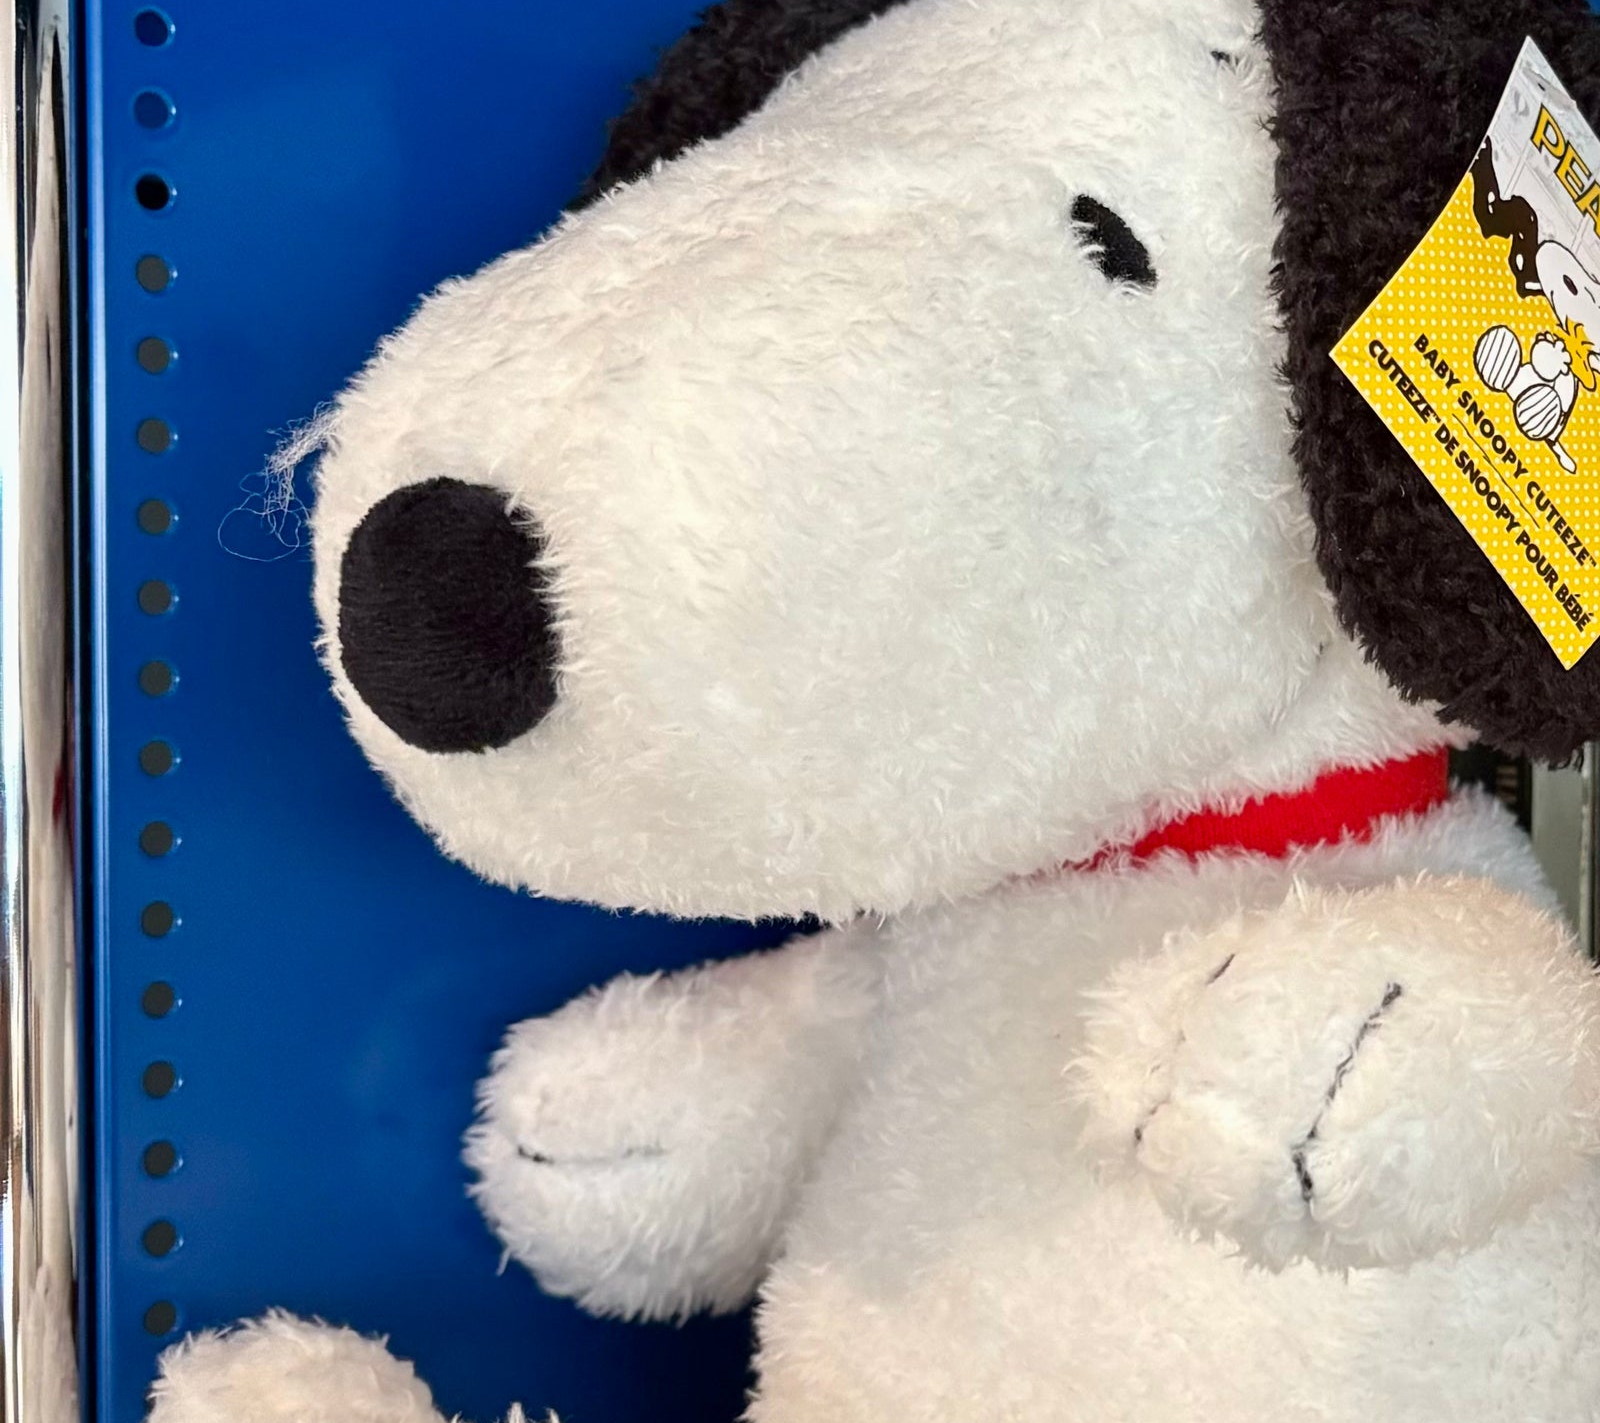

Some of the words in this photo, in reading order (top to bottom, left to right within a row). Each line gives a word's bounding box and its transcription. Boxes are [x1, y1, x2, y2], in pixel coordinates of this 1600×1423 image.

[1413, 333, 1461, 390] BABY
[1457, 391, 1528, 480] SNOOPY
[1435, 423, 1459, 456] DE
[1455, 449, 1521, 534] SNOOPY
[1515, 530, 1561, 592] POUR
[1554, 583, 1594, 633] BÉBÉ
